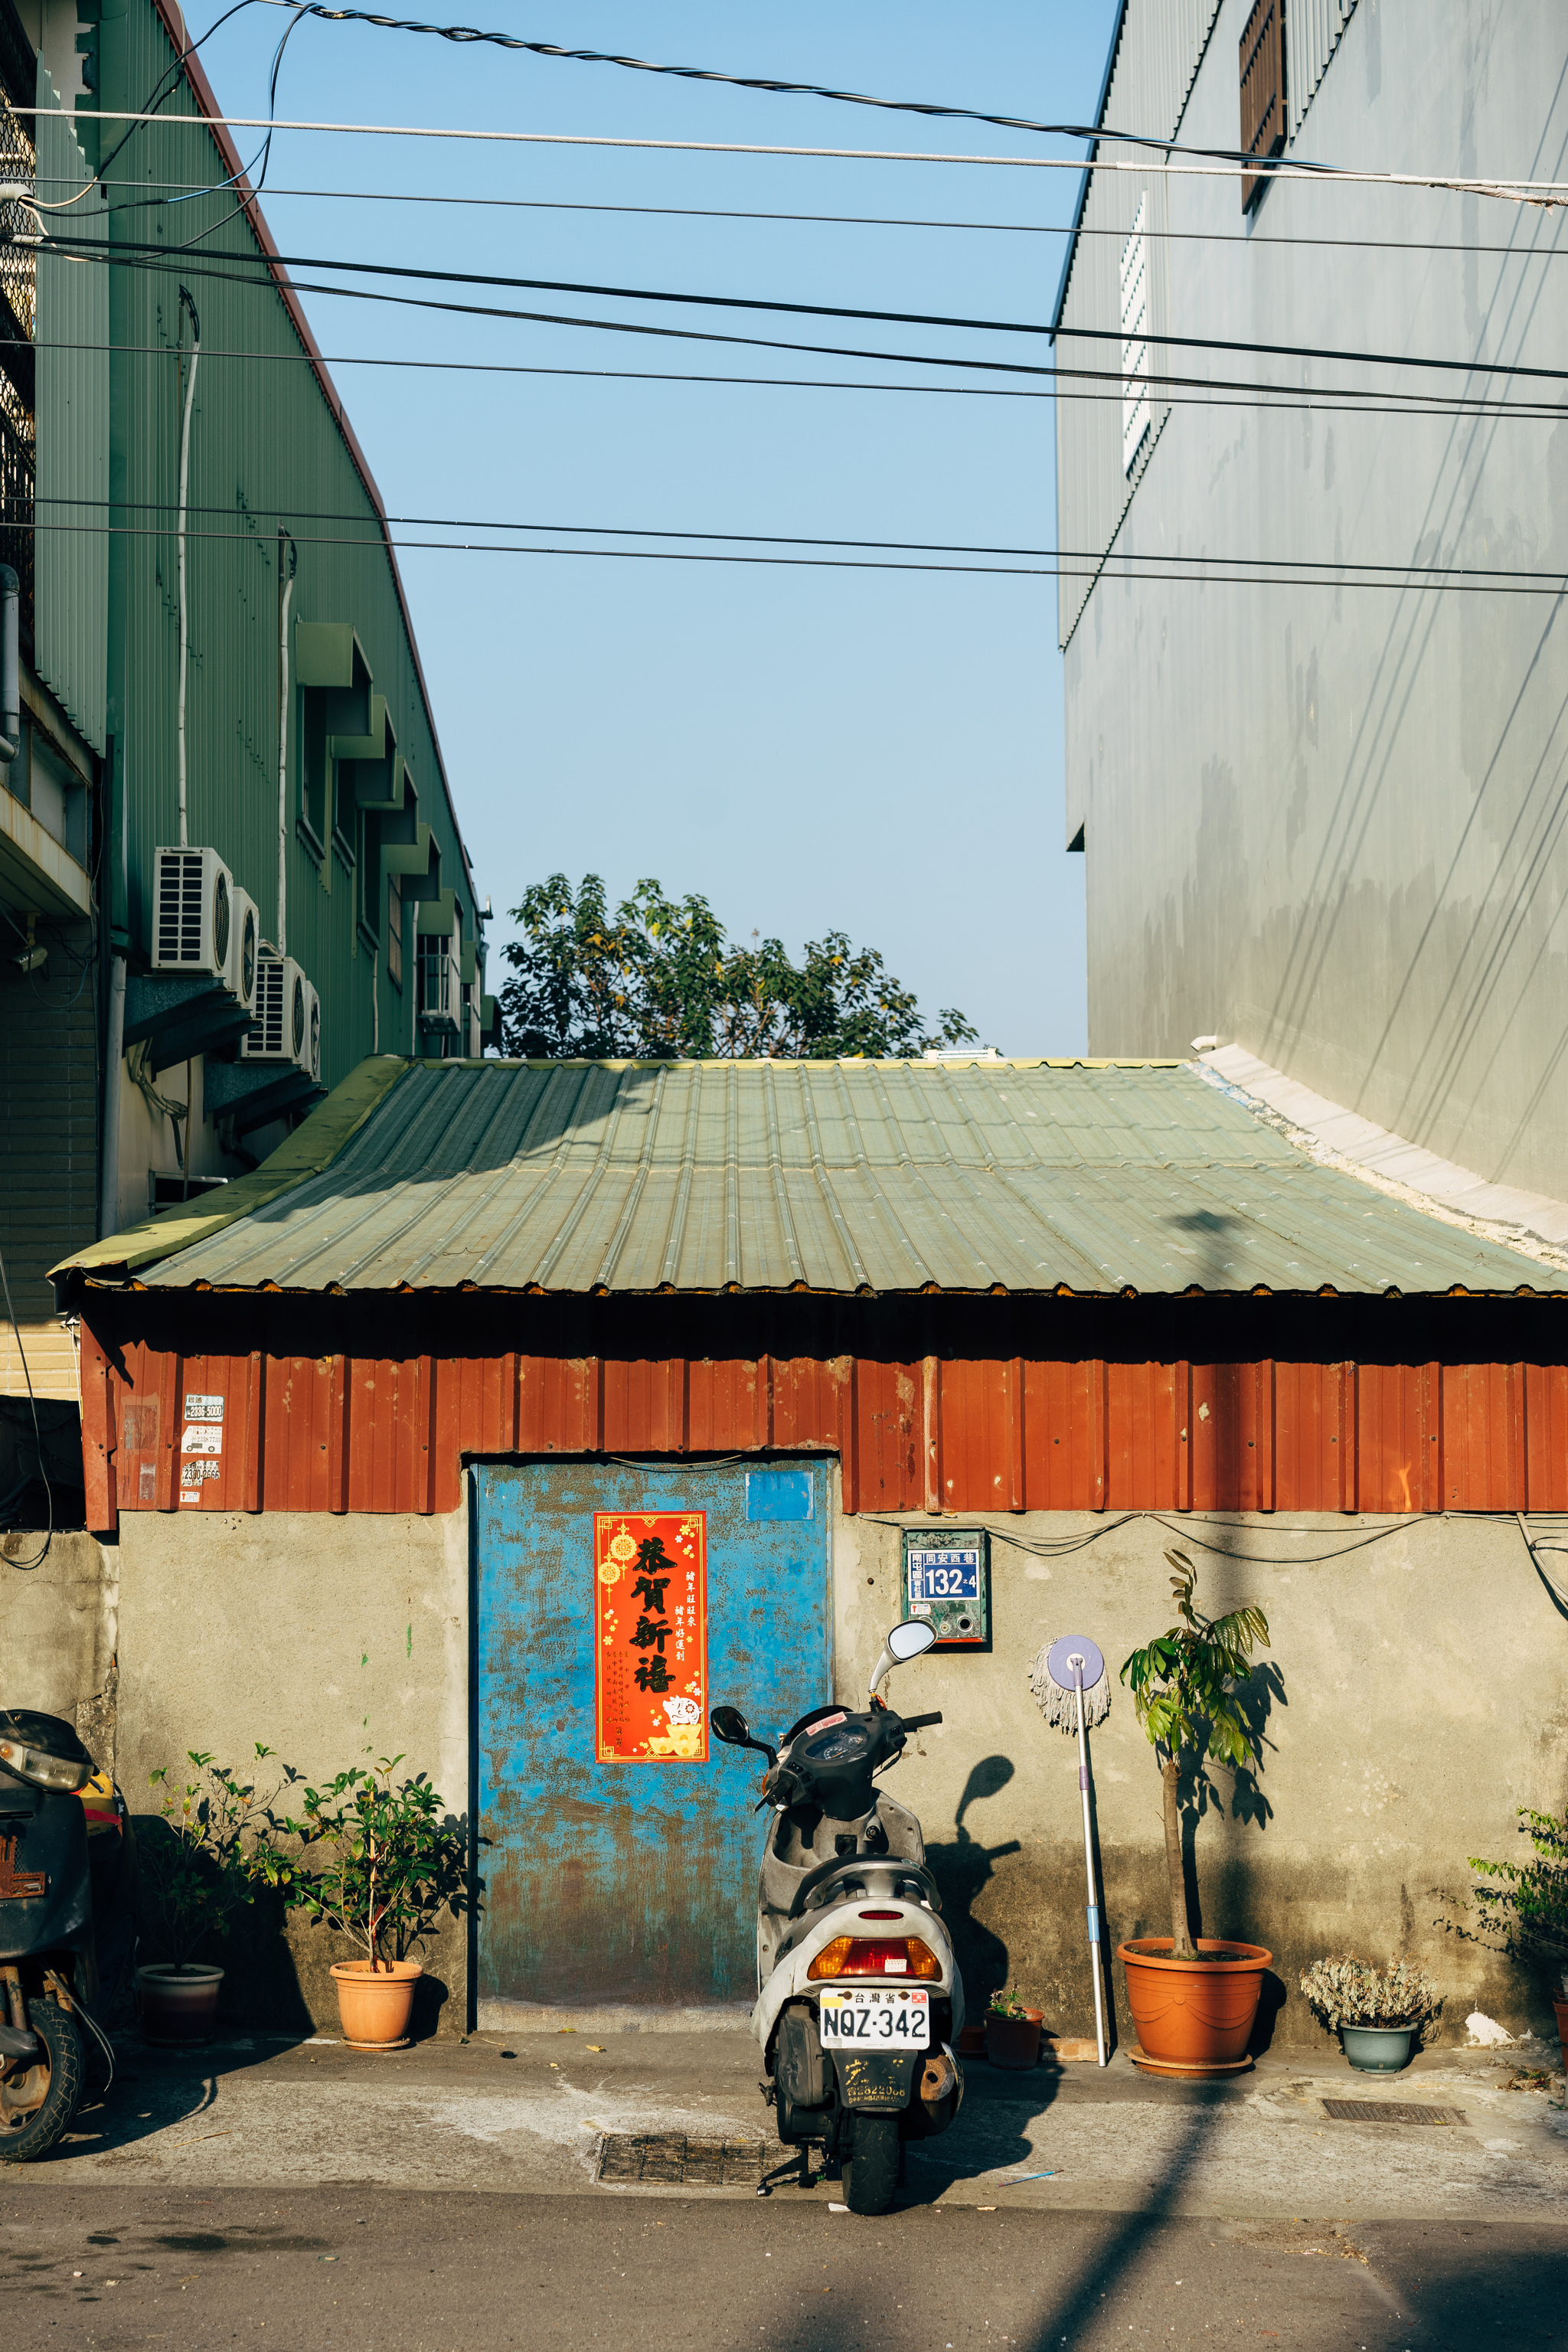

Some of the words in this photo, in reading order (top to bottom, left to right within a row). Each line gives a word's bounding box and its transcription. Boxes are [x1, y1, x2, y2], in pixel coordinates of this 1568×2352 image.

[912, 1553, 923, 1579] 南屯區
[926, 1553, 975, 1563] 同安西巷
[629, 1537, 678, 1693] 恭賀新禧
[686, 1571, 696, 1627] 豬年旺旺來
[675, 1606, 685, 1661] 豬年好運到
[855, 1993, 895, 2004] 台灣省
